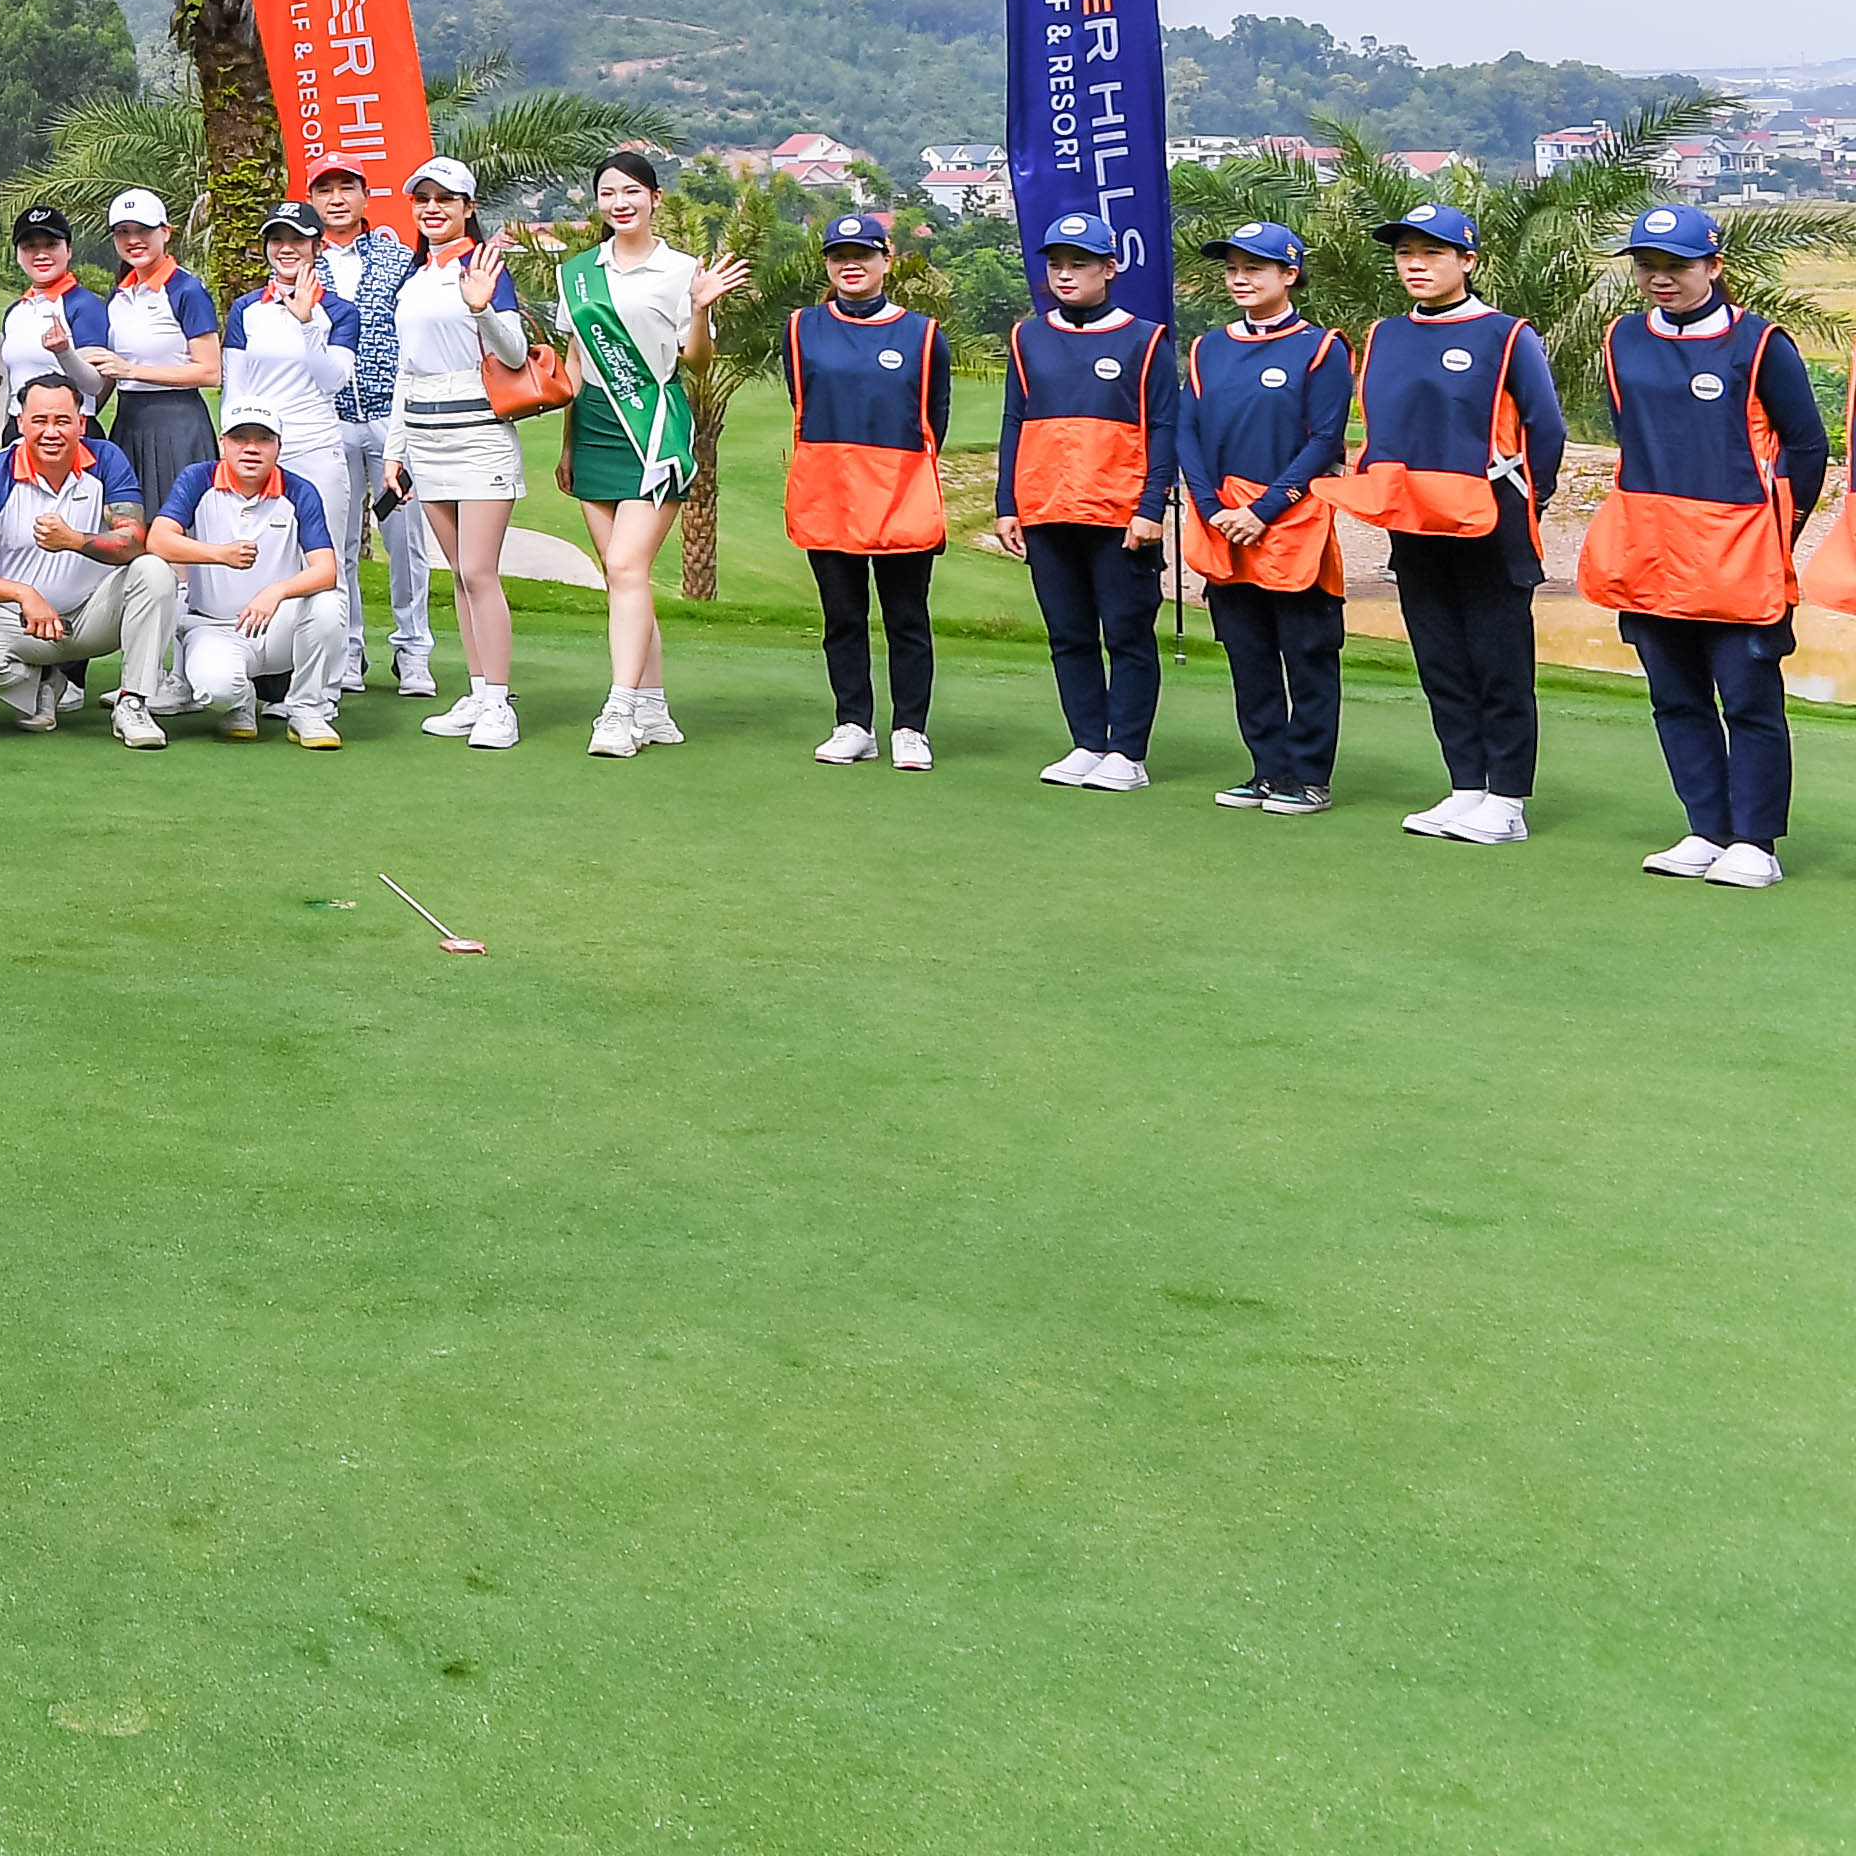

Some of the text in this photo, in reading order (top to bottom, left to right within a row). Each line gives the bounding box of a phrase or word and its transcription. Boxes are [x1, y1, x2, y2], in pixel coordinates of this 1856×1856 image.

[293, 42, 313, 60] &
[1047, 24, 1072, 45] &
[296, 69, 325, 166] RESOR
[1048, 55, 1081, 173] RESORT
[1088, 81, 1147, 274] HILLS
